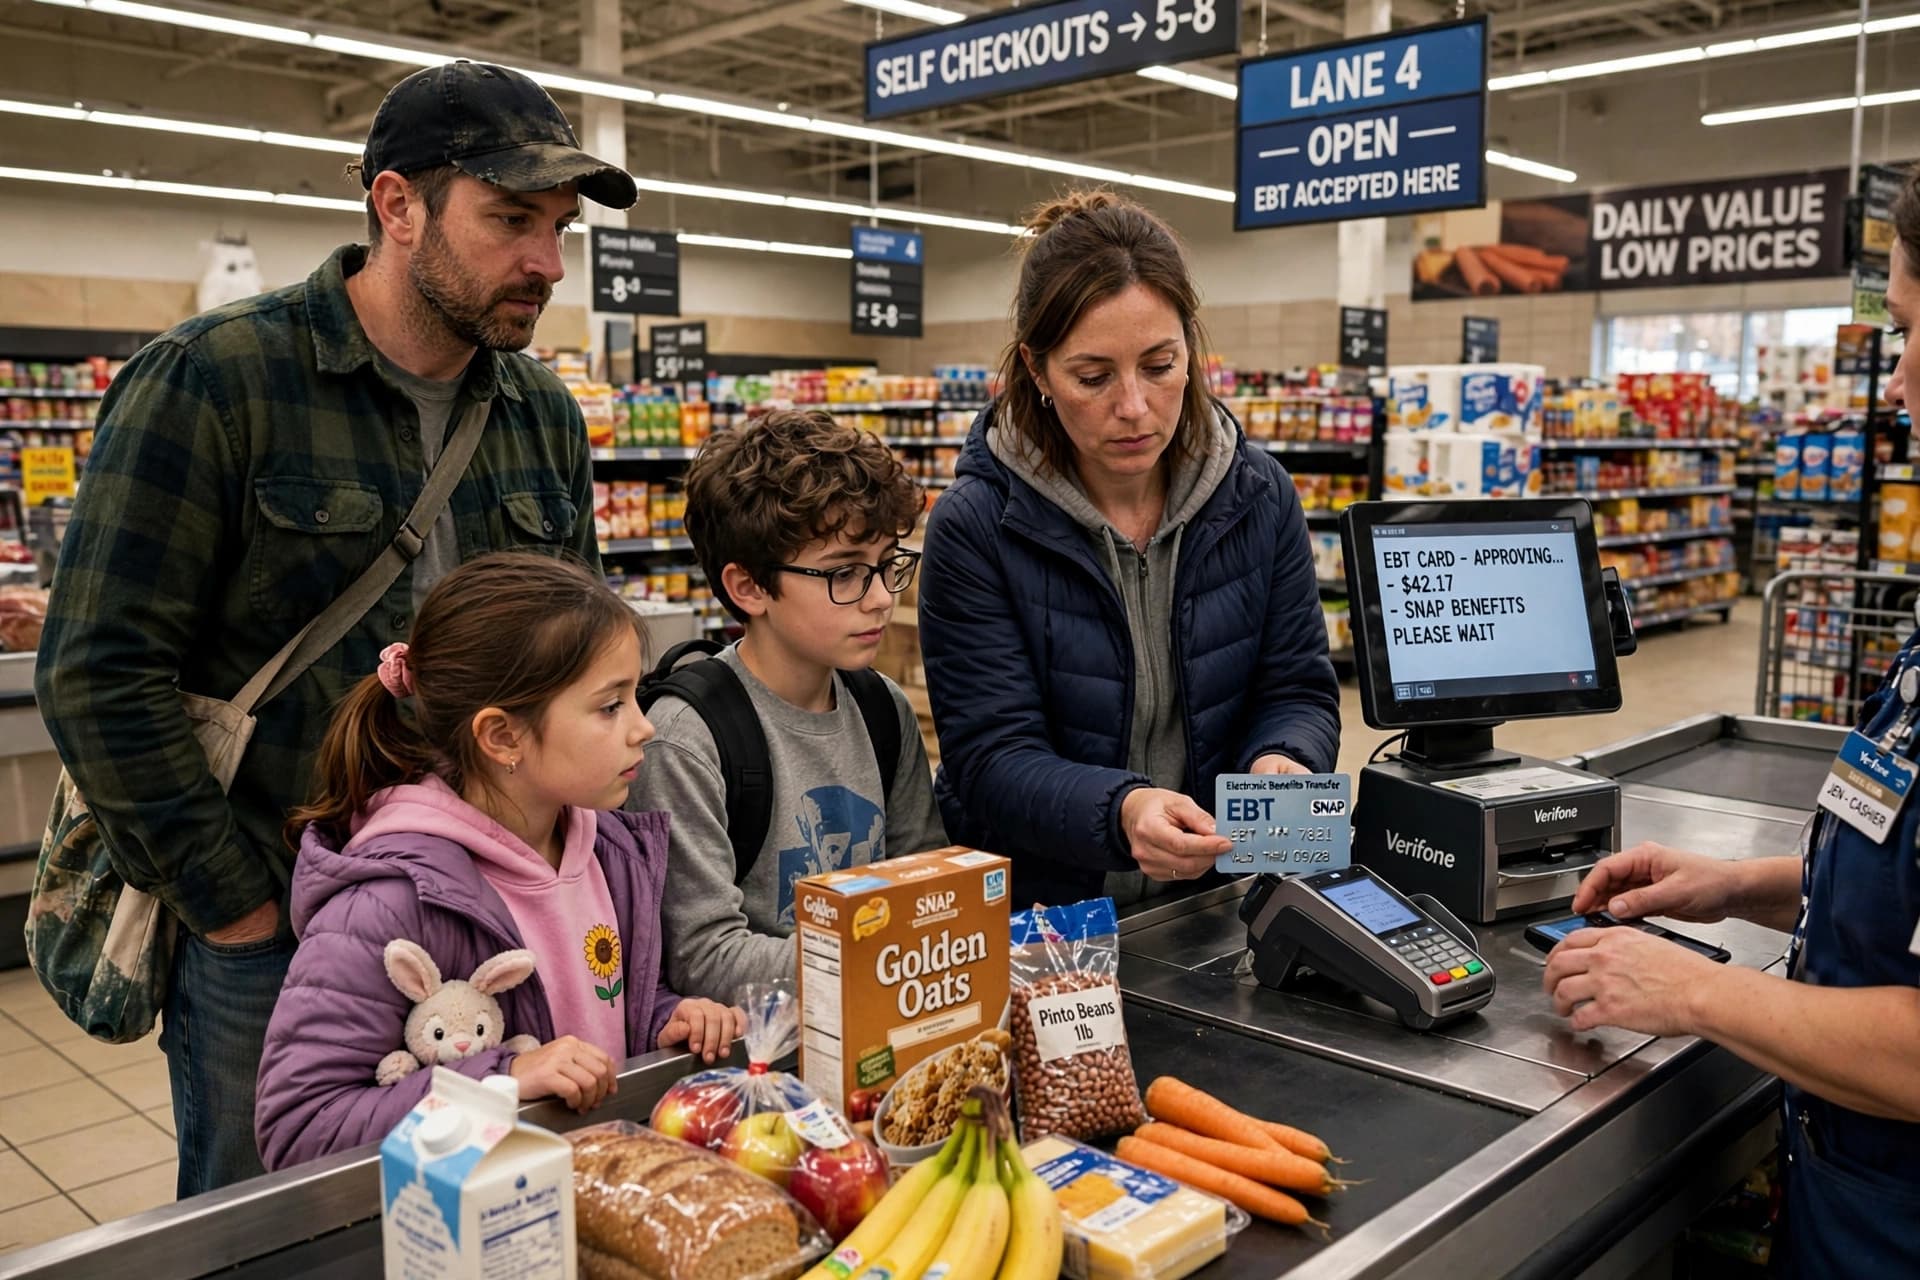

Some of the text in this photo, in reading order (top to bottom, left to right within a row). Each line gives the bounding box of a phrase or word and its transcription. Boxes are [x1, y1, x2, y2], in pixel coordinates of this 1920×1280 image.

[876, 0, 1217, 98] SELF CHECKOUTS 5-8
[1290, 45, 1422, 109] LANE 4
[1307, 116, 1399, 167] OPEN
[1254, 163, 1461, 213] EBT ACCEPTED HERE
[1592, 194, 1694, 242] DAILY
[1702, 184, 1826, 230] VALUE
[904, 239, 918, 259] 4
[1601, 237, 1680, 280] LOW
[1687, 228, 1821, 275] PRICES
[1383, 551, 1412, 569] EBT
[1417, 550, 1456, 568] CARD
[1474, 547, 1564, 567] APPROVING...
[1401, 574, 1453, 596] $42.17
[1405, 600, 1445, 619] SNAP
[1452, 596, 1526, 617] BENEFITS
[1393, 623, 1496, 646] PLEASE WAIT
[1226, 780, 1267, 791] Electronic
[1305, 779, 1341, 790] Transfer
[1227, 798, 1345, 822] EBT SNAP
[1534, 805, 1578, 824] Verifone
[1827, 783, 1845, 800] JEN
[1850, 796, 1886, 829] CASHIER
[1293, 850, 1330, 864] 09/28
[1386, 829, 1456, 869] Verifone
[915, 890, 957, 918] SNAP
[875, 929, 988, 986] Golden
[898, 971, 972, 1020] Oats
[1038, 1001, 1115, 1028] Pinto Beans
[1073, 1023, 1094, 1041] 1lb
